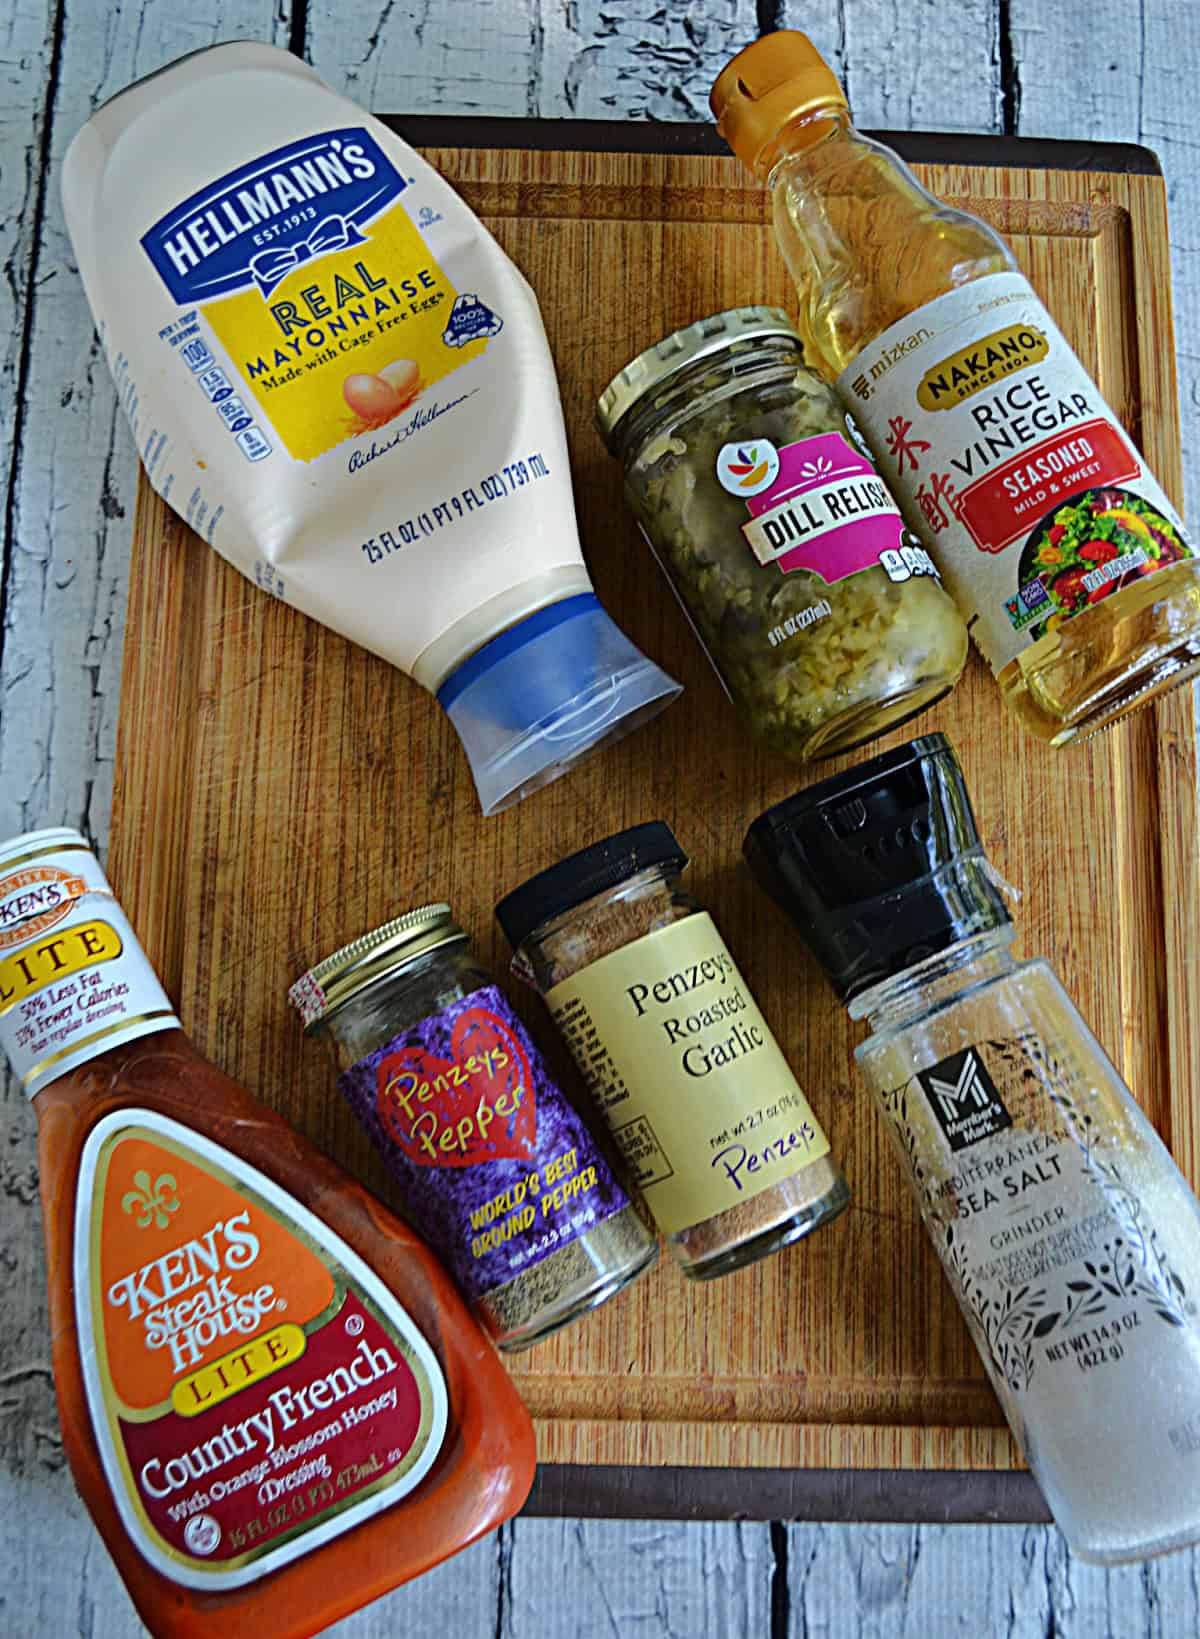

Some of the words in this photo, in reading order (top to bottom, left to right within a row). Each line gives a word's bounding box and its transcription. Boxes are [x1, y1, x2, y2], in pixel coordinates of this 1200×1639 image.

[163, 139, 376, 277] HELLMANN'S
[245, 270, 437, 379] MAYONNAISE
[270, 261, 387, 336] REAL
[450, 307, 486, 325] 100%
[183, 339, 208, 364] 100
[261, 364, 304, 392] Made
[305, 348, 338, 373] with
[339, 331, 377, 352] Cage
[376, 311, 408, 334] Free
[409, 290, 445, 316] Eggs
[956, 369, 998, 399] SINCE
[1000, 355, 1030, 374] 1804
[971, 376, 1051, 432] RICE
[950, 394, 1094, 477] VINEGAR
[1002, 437, 1094, 499] SEASONED
[362, 539, 384, 564] 25
[380, 531, 401, 553] FL
[398, 520, 420, 544] OZ
[417, 512, 434, 536] (1
[432, 501, 454, 527] PT
[451, 496, 464, 517] 9
[462, 488, 484, 511] FL
[480, 473, 508, 501] OZ)
[502, 461, 529, 492] 739
[1013, 490, 1047, 515] MILD
[1049, 482, 1060, 494] &
[1062, 461, 1102, 488] SWEET
[762, 502, 824, 550] DILL
[772, 624, 788, 642] FL
[781, 616, 801, 637] OZ
[20, 996, 48, 1021] 50%
[49, 980, 78, 1005] Less
[79, 970, 103, 993] Fat
[37, 1005, 73, 1035] Fewer
[76, 981, 130, 1011] Calories
[625, 951, 733, 1017] Penzeys
[662, 986, 747, 1045] Roasted
[681, 1021, 764, 1078] Garlic
[385, 1046, 510, 1119] Penzeys
[410, 1085, 525, 1160] Pepper
[709, 1129, 730, 1149] net
[945, 1102, 1003, 1137] Member's
[711, 1121, 816, 1191] Penzeys
[956, 1187, 1000, 1219] SEA
[1002, 1154, 1063, 1198] SALT
[468, 1171, 541, 1232] WORLD'S
[544, 1148, 579, 1186] BEST
[471, 1205, 536, 1259] GROUND
[540, 1165, 599, 1219] PEPPER
[989, 1206, 1066, 1250] GRINDER
[107, 1209, 260, 1321] KEN'S
[143, 1275, 245, 1349] Steak
[166, 1284, 277, 1375] House
[1044, 1341, 1069, 1363] NET
[1067, 1333, 1091, 1353] WT
[1091, 1319, 1122, 1344] 14.9
[1121, 1311, 1142, 1332] OZ
[187, 1334, 289, 1405] LITE
[1076, 1346, 1112, 1374] (422
[140, 1405, 276, 1498] Country
[269, 1338, 399, 1431] French
[168, 1490, 210, 1522] With
[209, 1460, 272, 1497] Orange
[271, 1420, 342, 1469] Blossom
[340, 1387, 399, 1429] Honey
